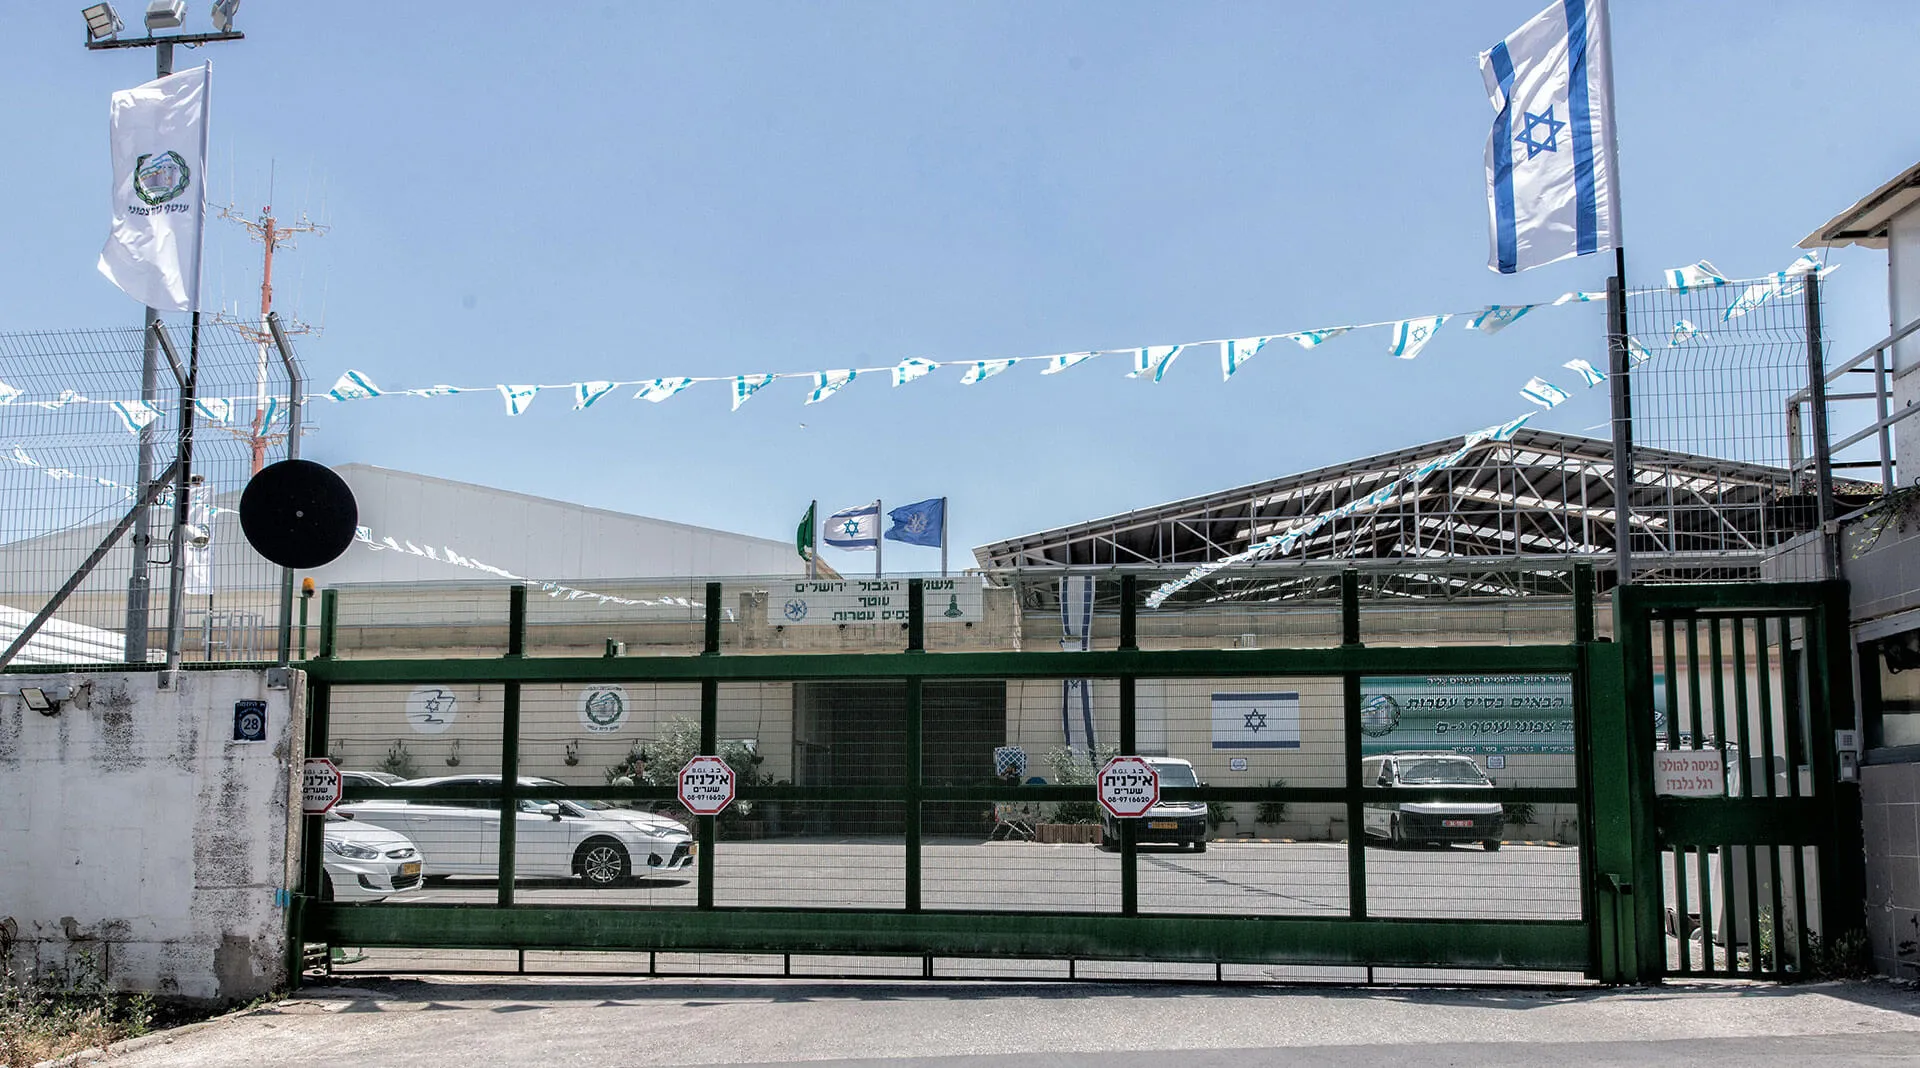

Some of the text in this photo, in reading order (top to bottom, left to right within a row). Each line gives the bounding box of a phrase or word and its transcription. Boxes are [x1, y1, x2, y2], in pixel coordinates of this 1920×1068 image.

[164, 203, 190, 214] עוטף
[795, 579, 954, 593] משמ הגבול ירושלים
[858, 596, 890, 608] עוטף
[832, 611, 875, 621] עטרות
[1405, 697, 1458, 710] עטרות
[1510, 696, 1565, 709] הבאים
[243, 718, 259, 730] 28
[1470, 720, 1510, 737] עוטף
[1658, 758, 1719, 771] כניסה להולכי
[684, 774, 729, 785] אילנית
[1104, 775, 1153, 786] אילנית
[1696, 776, 1713, 789] רגל
